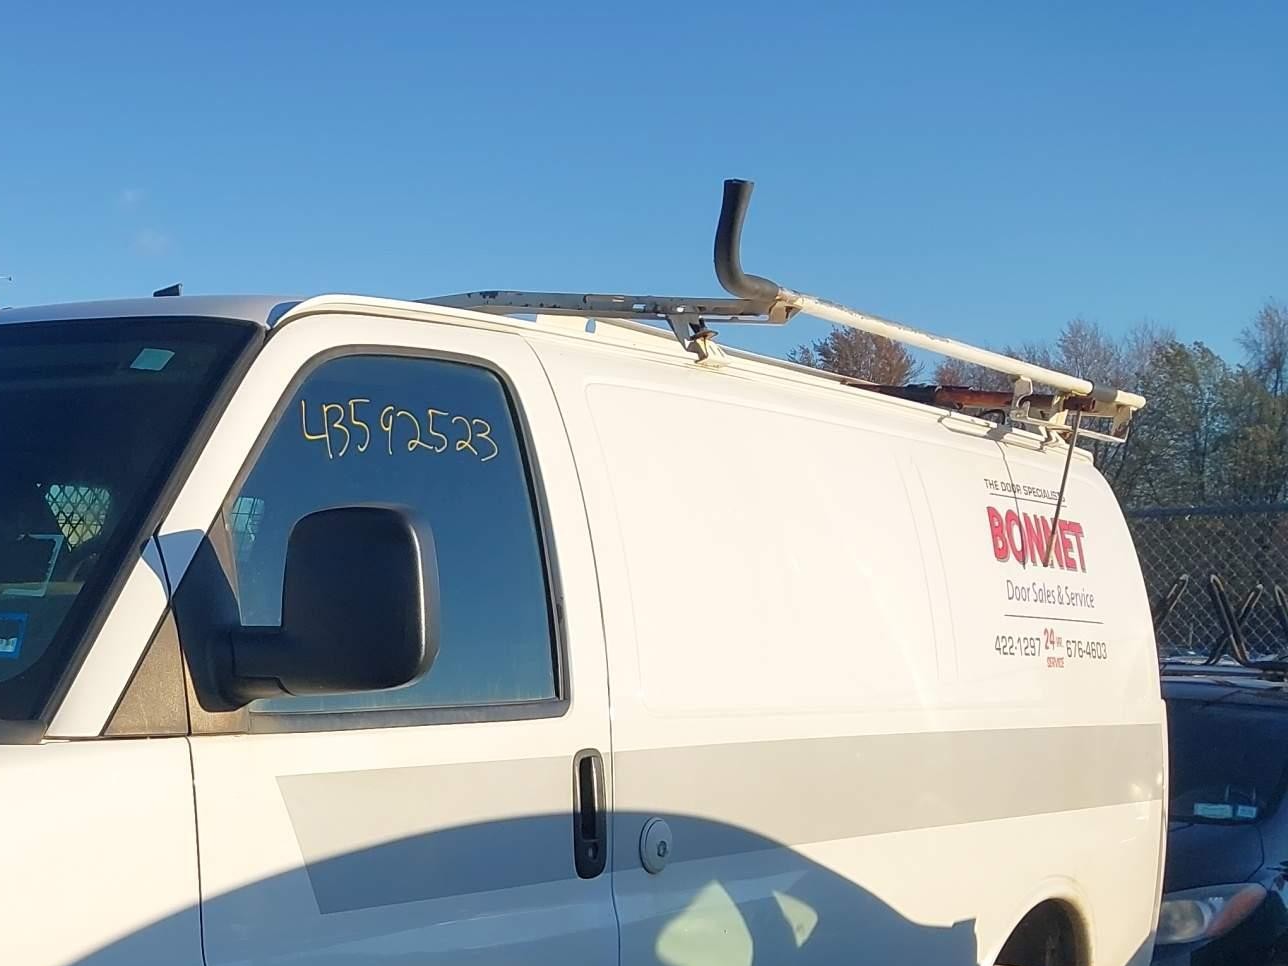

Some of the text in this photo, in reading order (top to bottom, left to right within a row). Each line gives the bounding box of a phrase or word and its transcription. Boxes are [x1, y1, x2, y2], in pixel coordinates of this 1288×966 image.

[300, 399, 499, 461] 4B592523
[984, 479, 999, 490] THE
[1000, 481, 1022, 493] DOOR
[986, 506, 1087, 573] BONNET
[1006, 579, 1095, 608] Door Sales & Service
[1044, 628, 1055, 650] 24
